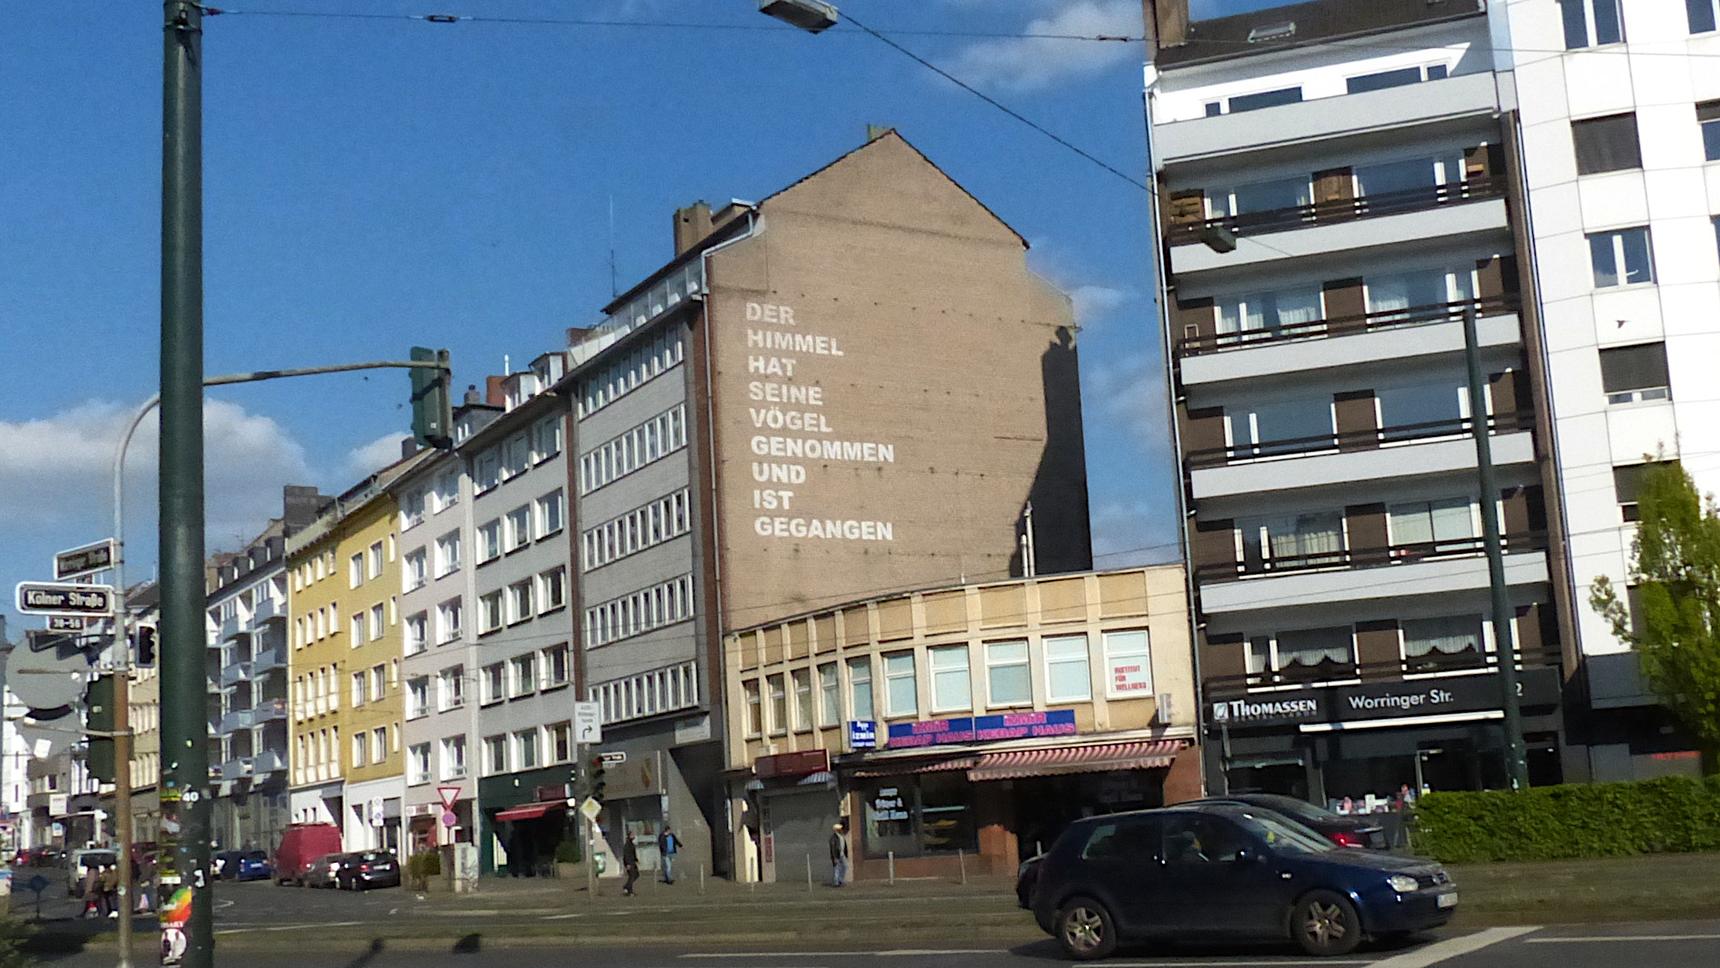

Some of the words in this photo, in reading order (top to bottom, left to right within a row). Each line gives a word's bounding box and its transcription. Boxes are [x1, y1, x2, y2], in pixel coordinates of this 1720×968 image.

[745, 302, 796, 326] DER
[747, 329, 845, 357] HIMMEL
[748, 355, 797, 377] HAT
[748, 381, 823, 406] SEINE
[749, 406, 833, 433] VÖGEL
[750, 435, 895, 463] GENOMMEN
[752, 462, 806, 484] UND
[753, 489, 794, 511] IST
[754, 516, 893, 541] GEGANGEN
[69, 592, 104, 608] Straße
[1349, 693, 1427, 710] Worringer
[1429, 689, 1455, 704] Str.
[1031, 722, 1076, 737] HAUS
[183, 791, 199, 802] 40
